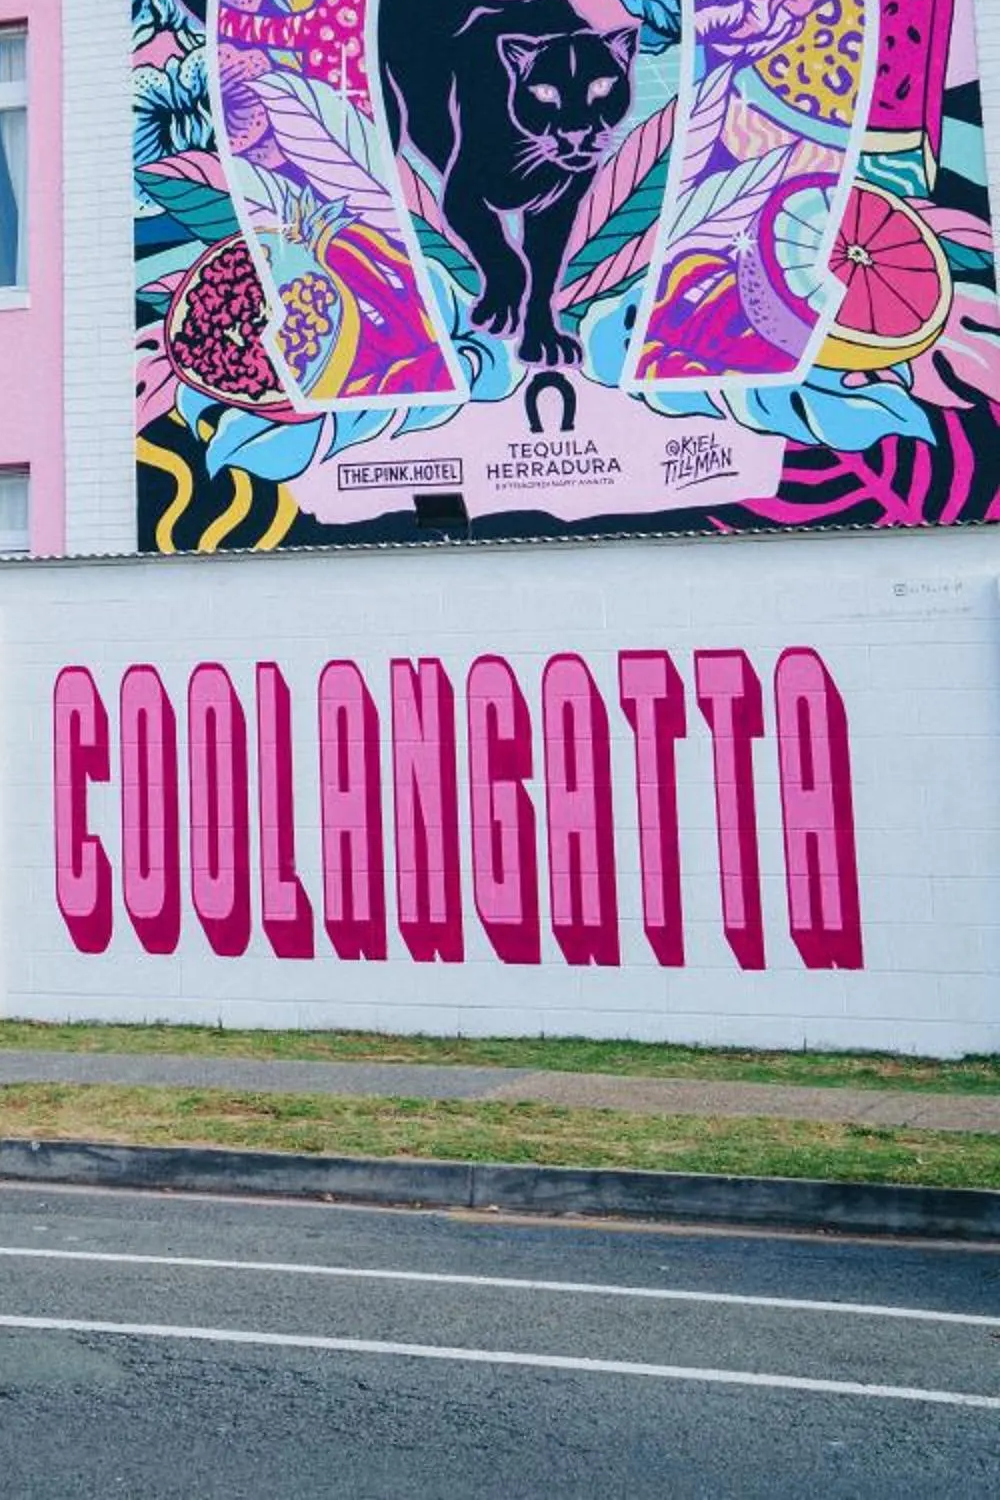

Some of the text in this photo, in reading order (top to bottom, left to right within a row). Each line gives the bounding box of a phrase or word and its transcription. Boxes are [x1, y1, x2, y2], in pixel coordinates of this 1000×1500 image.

[508, 439, 599, 459] TEQUILA
[665, 432, 720, 457] @KIEL
[486, 457, 622, 480] HERRADURA
[660, 447, 733, 485] TILLMAN
[53, 646, 864, 969] COOLANGATTA
